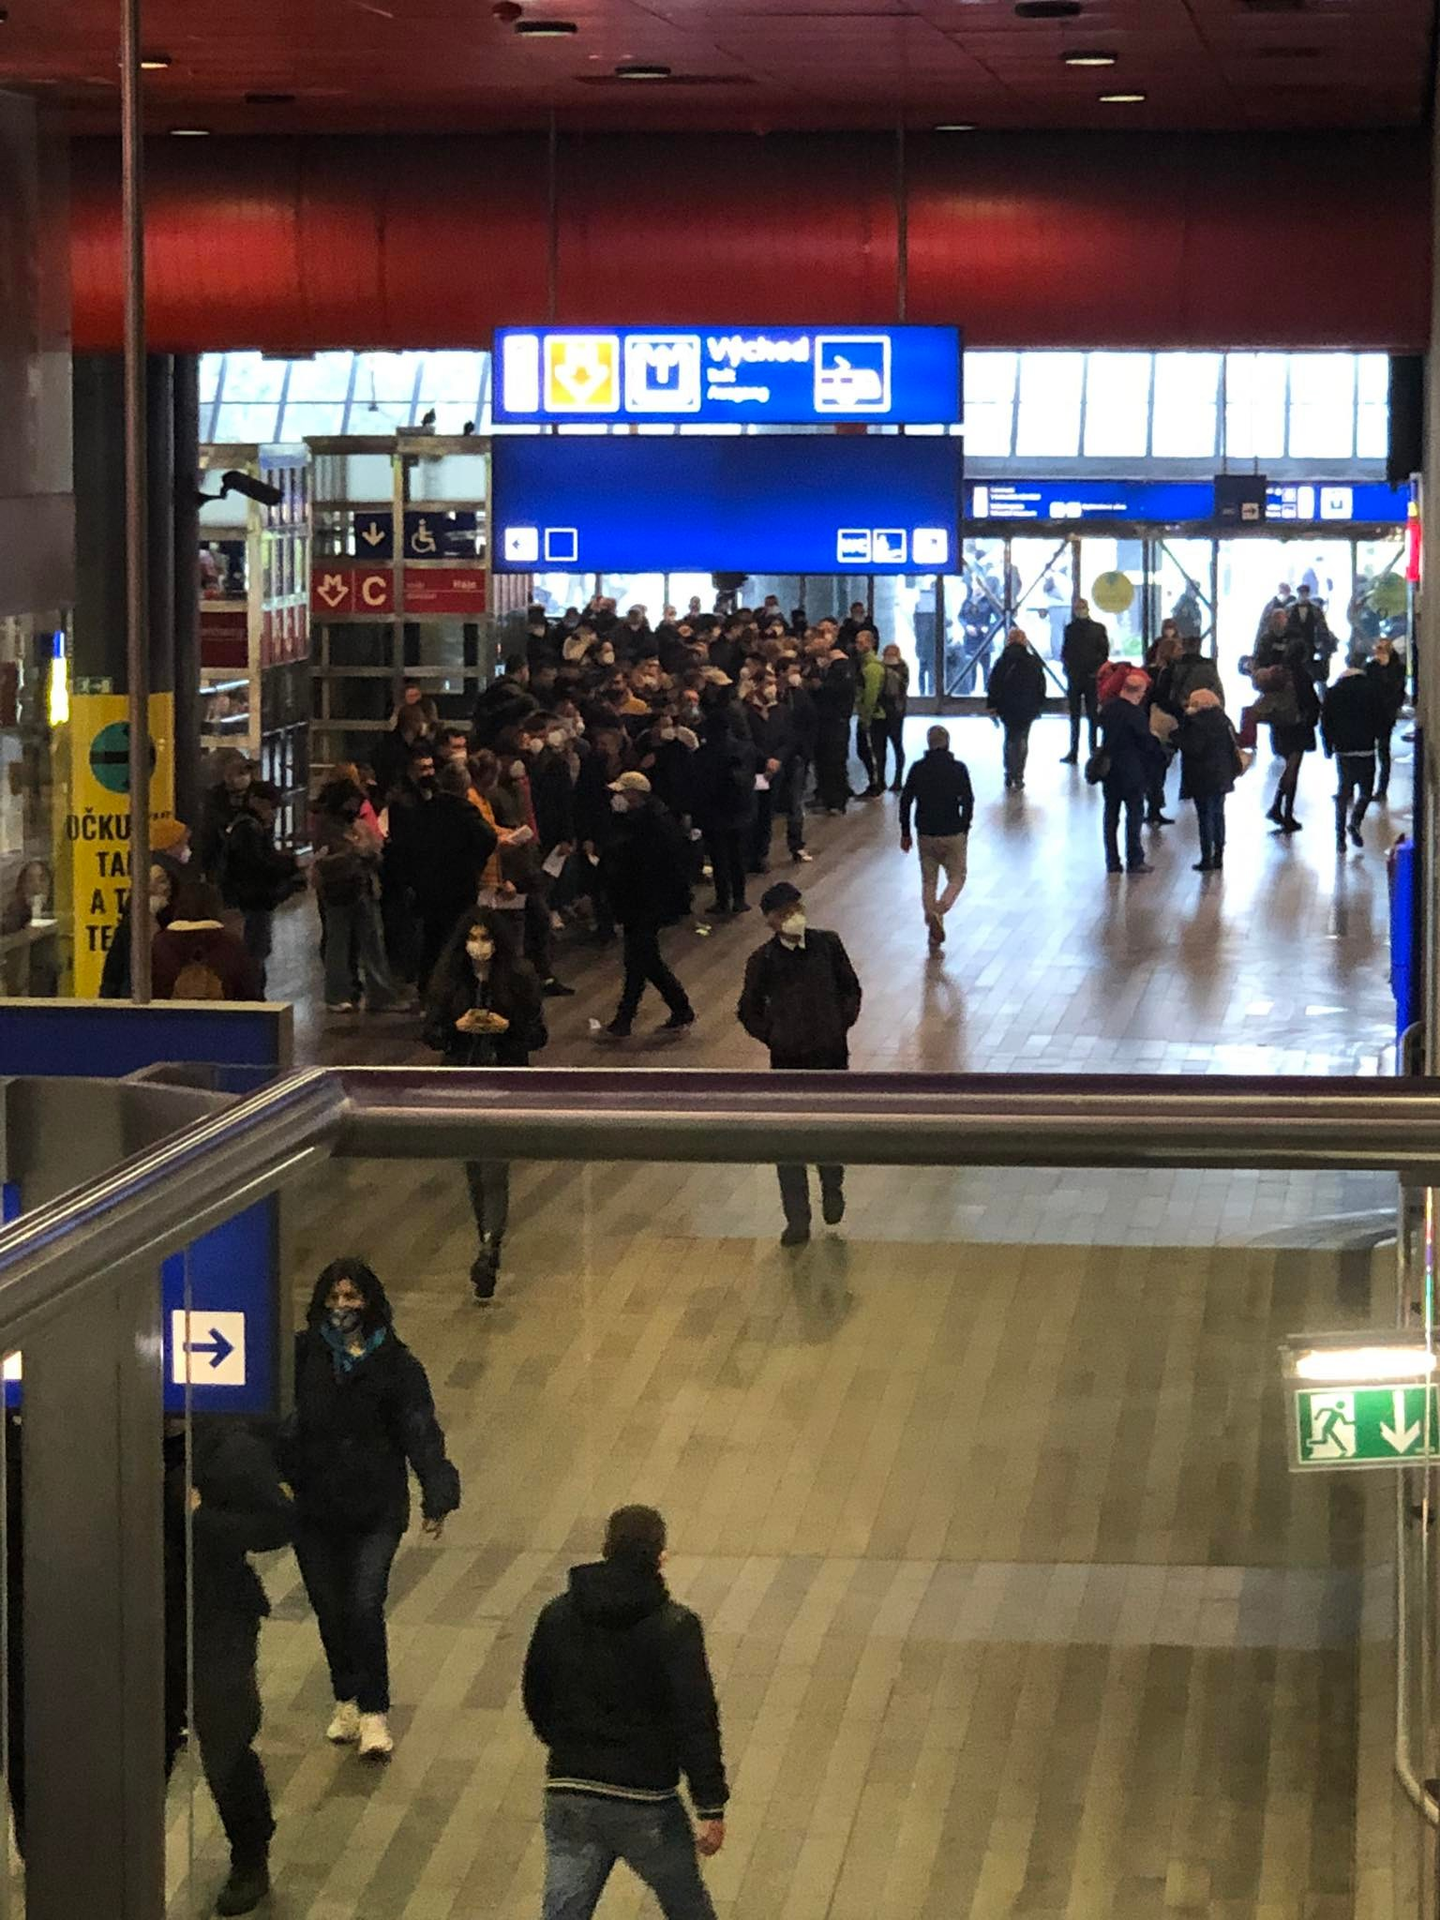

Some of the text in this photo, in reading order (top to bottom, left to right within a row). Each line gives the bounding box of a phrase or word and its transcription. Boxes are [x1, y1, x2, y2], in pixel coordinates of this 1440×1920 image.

[362, 576, 387, 606] C
[66, 807, 171, 841] OČKU
[96, 852, 131, 877] TA
[91, 888, 132, 915] A T
[86, 924, 114, 952] TE
